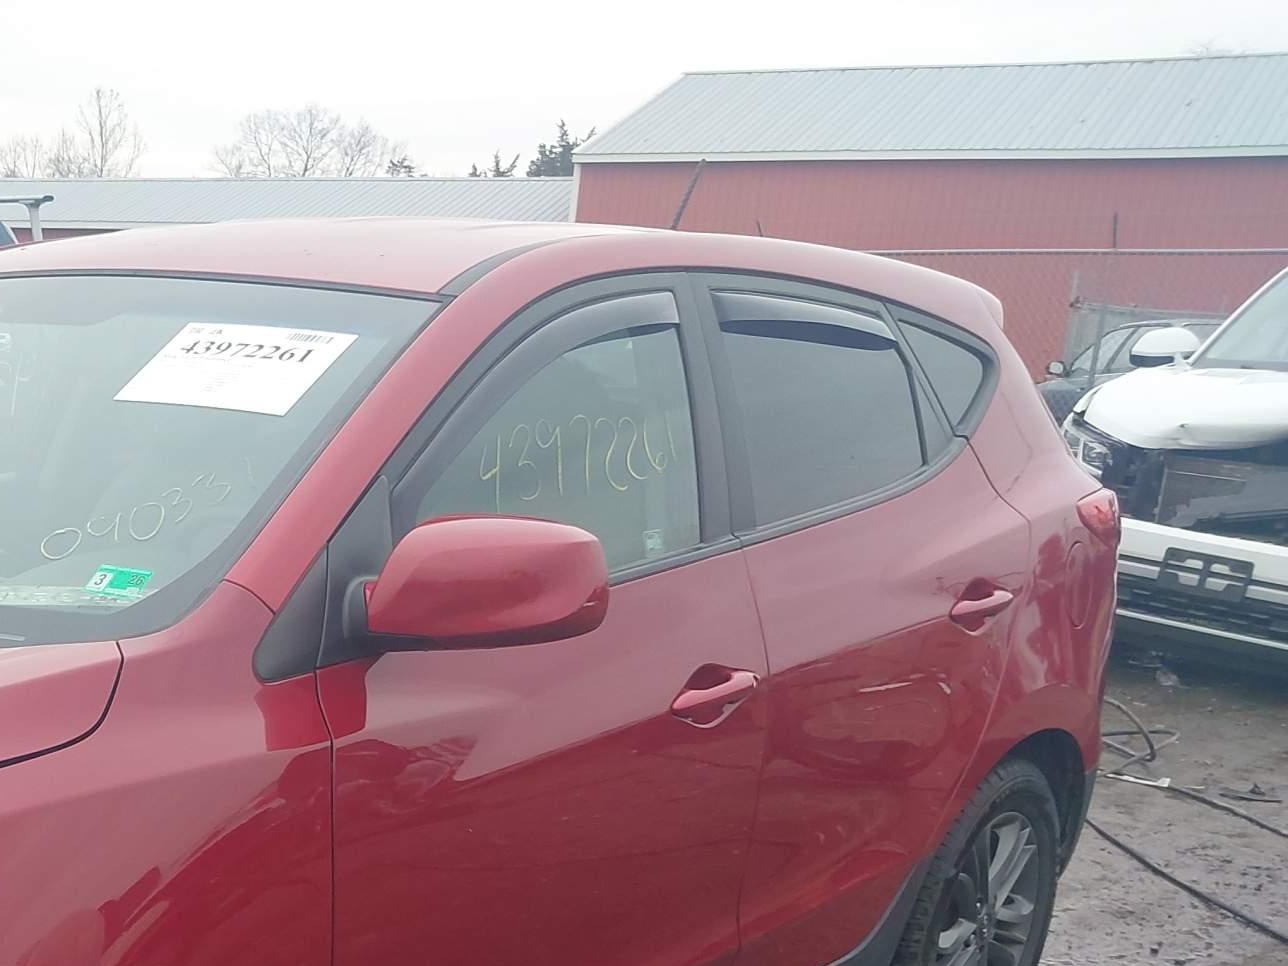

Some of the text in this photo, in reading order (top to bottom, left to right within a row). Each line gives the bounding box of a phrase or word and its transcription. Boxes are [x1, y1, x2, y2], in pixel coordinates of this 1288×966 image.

[180, 340, 314, 363] 43972261
[479, 412, 677, 514] 43972261
[94, 573, 144, 586] 3 26
